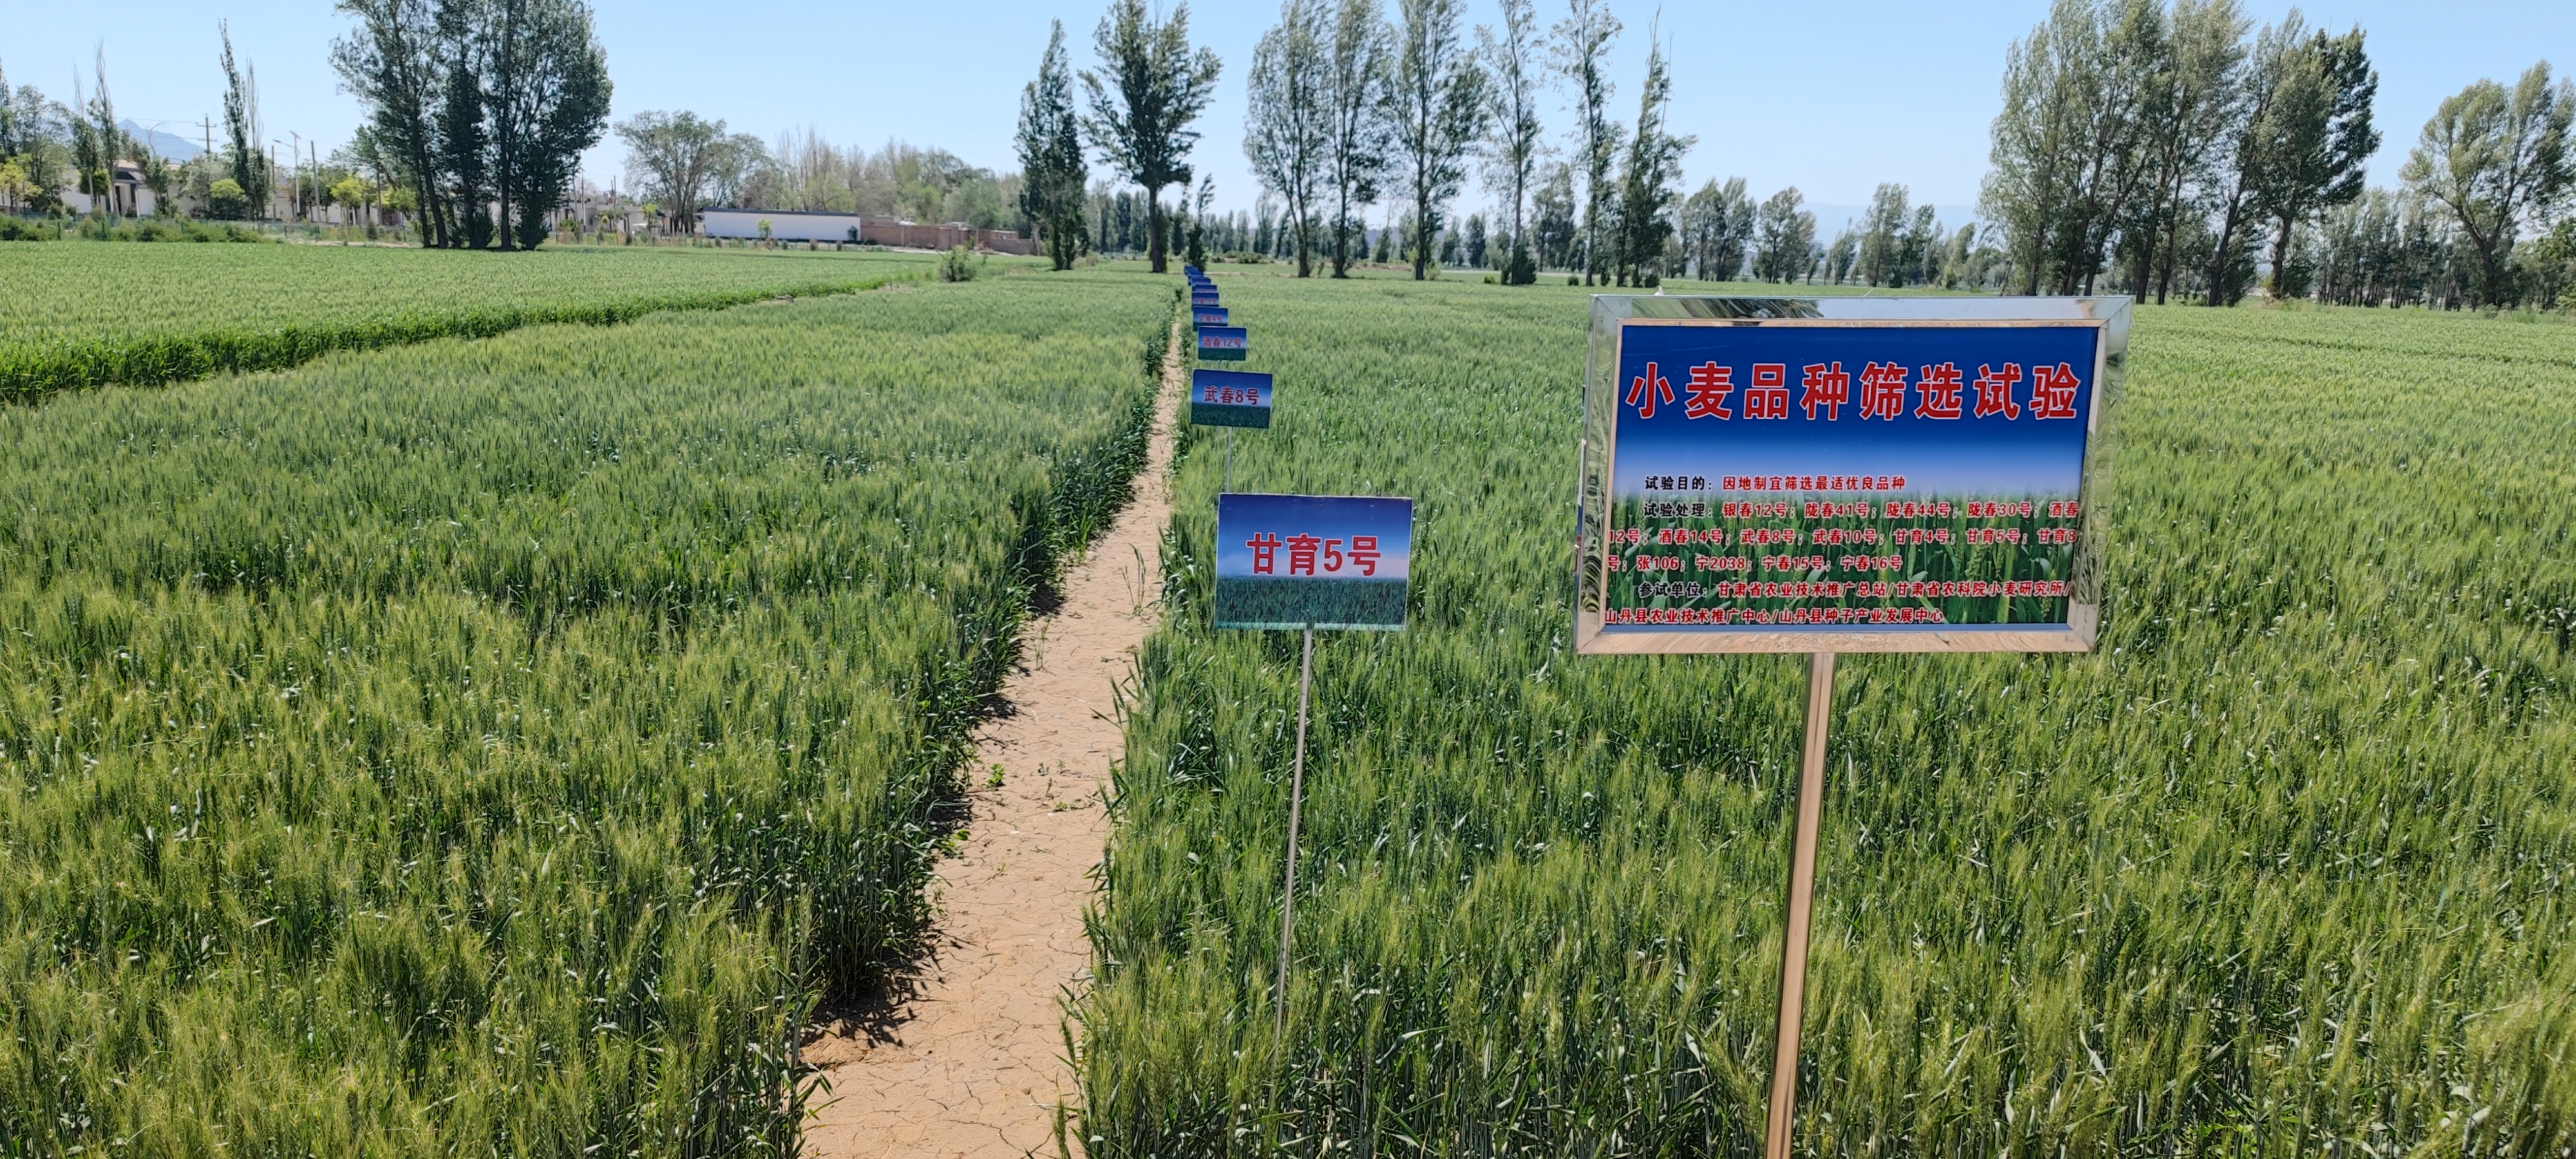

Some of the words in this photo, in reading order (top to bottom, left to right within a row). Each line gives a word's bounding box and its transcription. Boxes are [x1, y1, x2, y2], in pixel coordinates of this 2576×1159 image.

[1202, 335, 1242, 348] 酒春12号
[1203, 385, 1260, 405] 武春8号
[1625, 361, 2081, 422] 小麦品种筛选试验
[1645, 475, 1906, 491] 试验目的：因地制宜筛选最适优良品种
[1245, 532, 1381, 577] 甘育5号
[1605, 607, 1944, 625] 山丹县农业技术推广中心/山丹县种子产业发展中心
